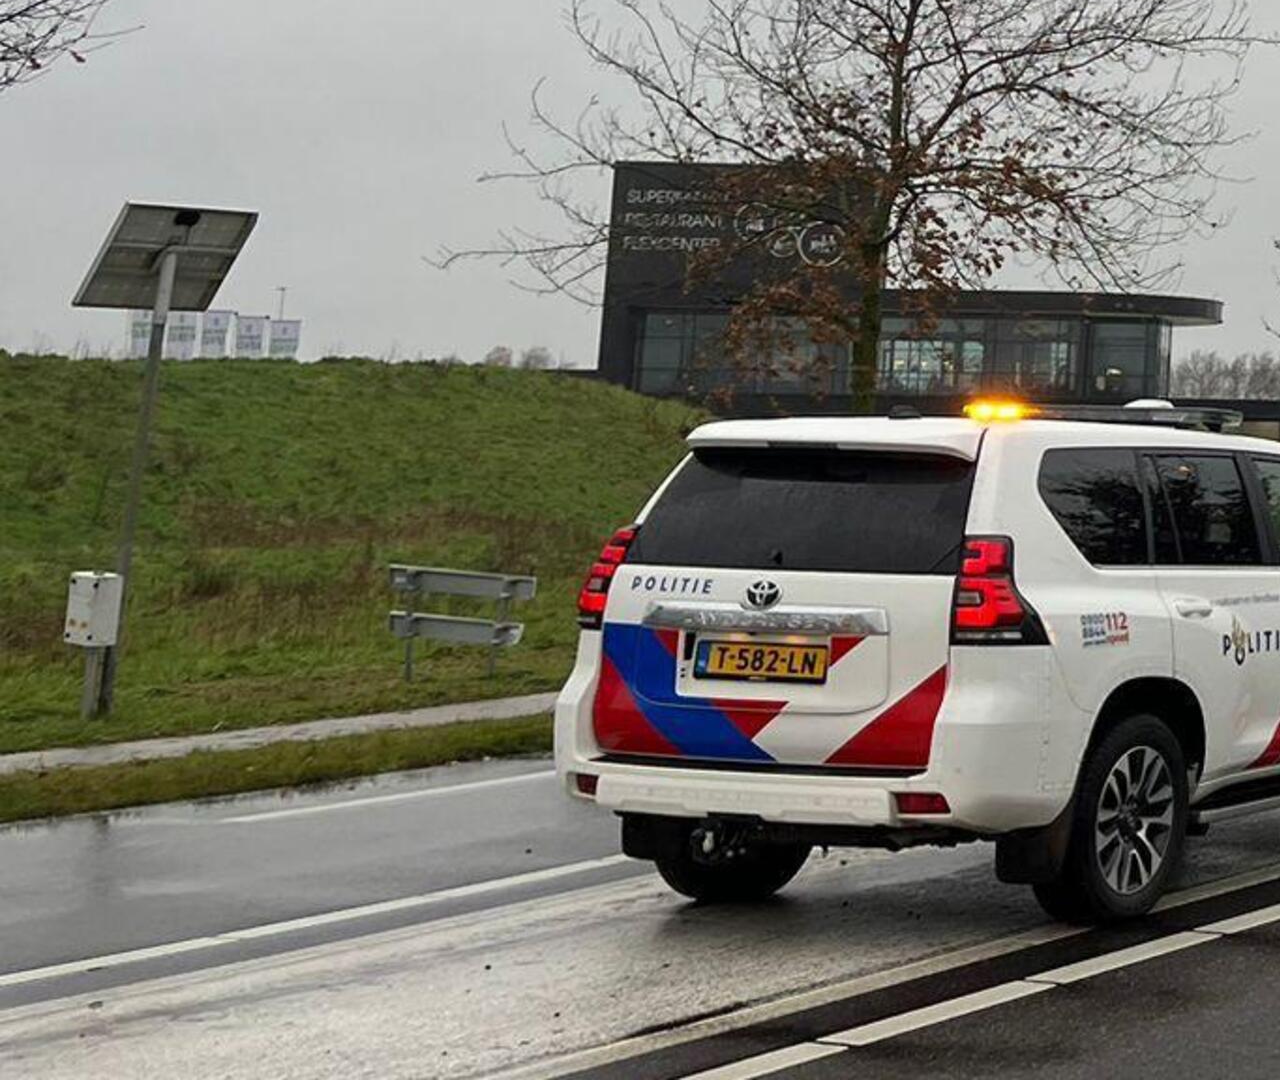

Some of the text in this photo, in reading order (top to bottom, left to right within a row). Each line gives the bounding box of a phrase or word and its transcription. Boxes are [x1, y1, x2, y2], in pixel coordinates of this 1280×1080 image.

[631, 575, 714, 594] POLITIE
[1105, 612, 1128, 630] 112
[717, 646, 818, 675] T-582-LN
